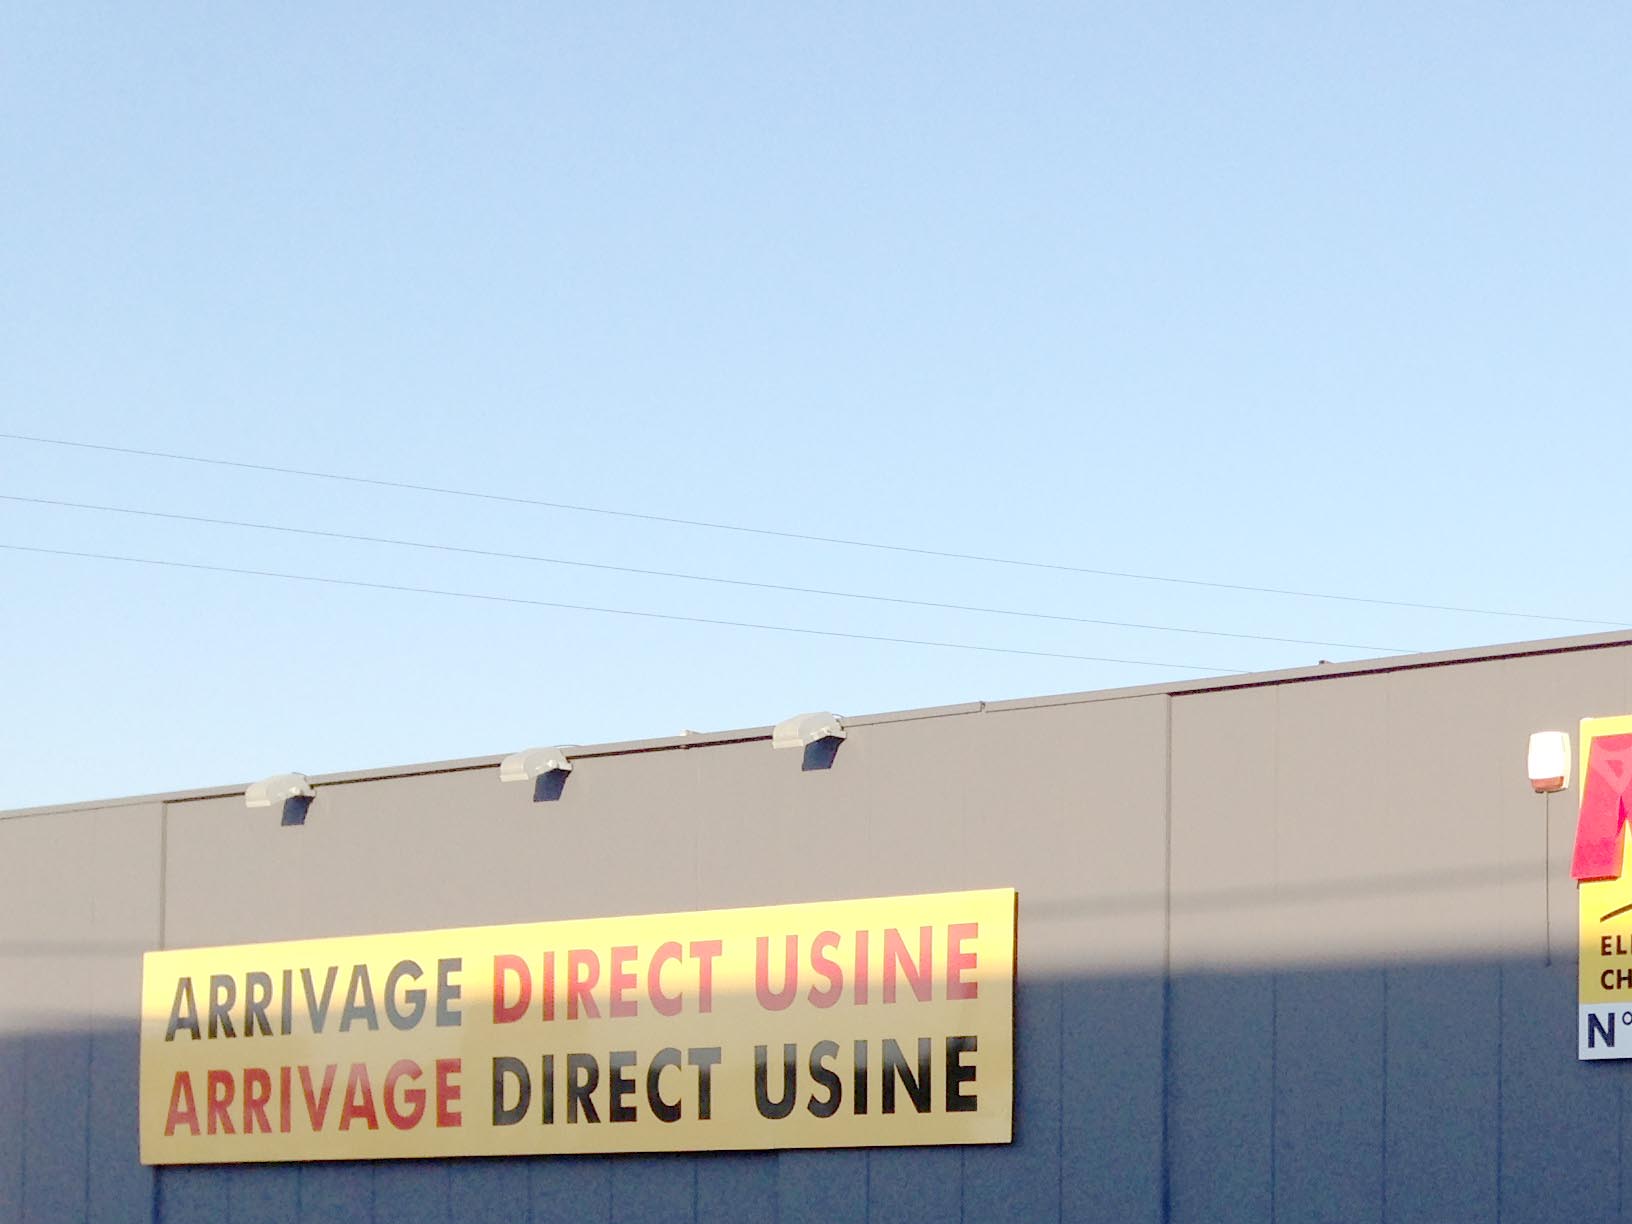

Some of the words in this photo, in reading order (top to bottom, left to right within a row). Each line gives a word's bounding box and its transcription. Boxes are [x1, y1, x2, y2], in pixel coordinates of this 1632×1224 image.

[165, 957, 462, 1042] ARRIVAGE
[492, 940, 723, 1024] DIRECT
[755, 923, 978, 1011] USINE
[164, 1058, 462, 1137] ARRIVAGE
[492, 1046, 723, 1126] DIRECT
[754, 1036, 978, 1119] USINE
